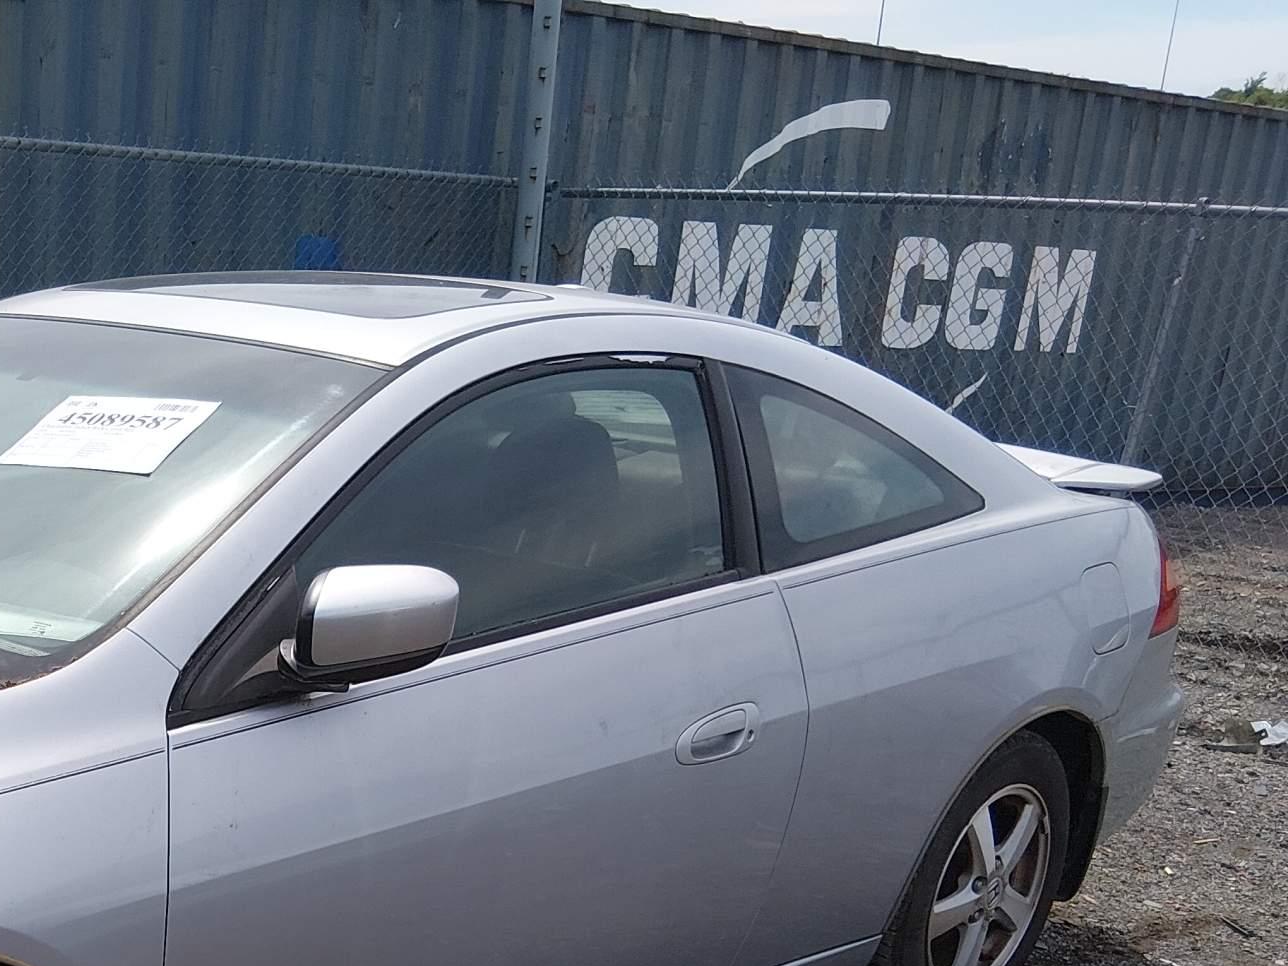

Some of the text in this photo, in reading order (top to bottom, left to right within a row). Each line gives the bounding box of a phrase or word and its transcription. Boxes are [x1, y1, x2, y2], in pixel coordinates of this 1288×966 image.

[581, 215, 1097, 354] CMA CGM
[57, 412, 184, 431] 45089587
